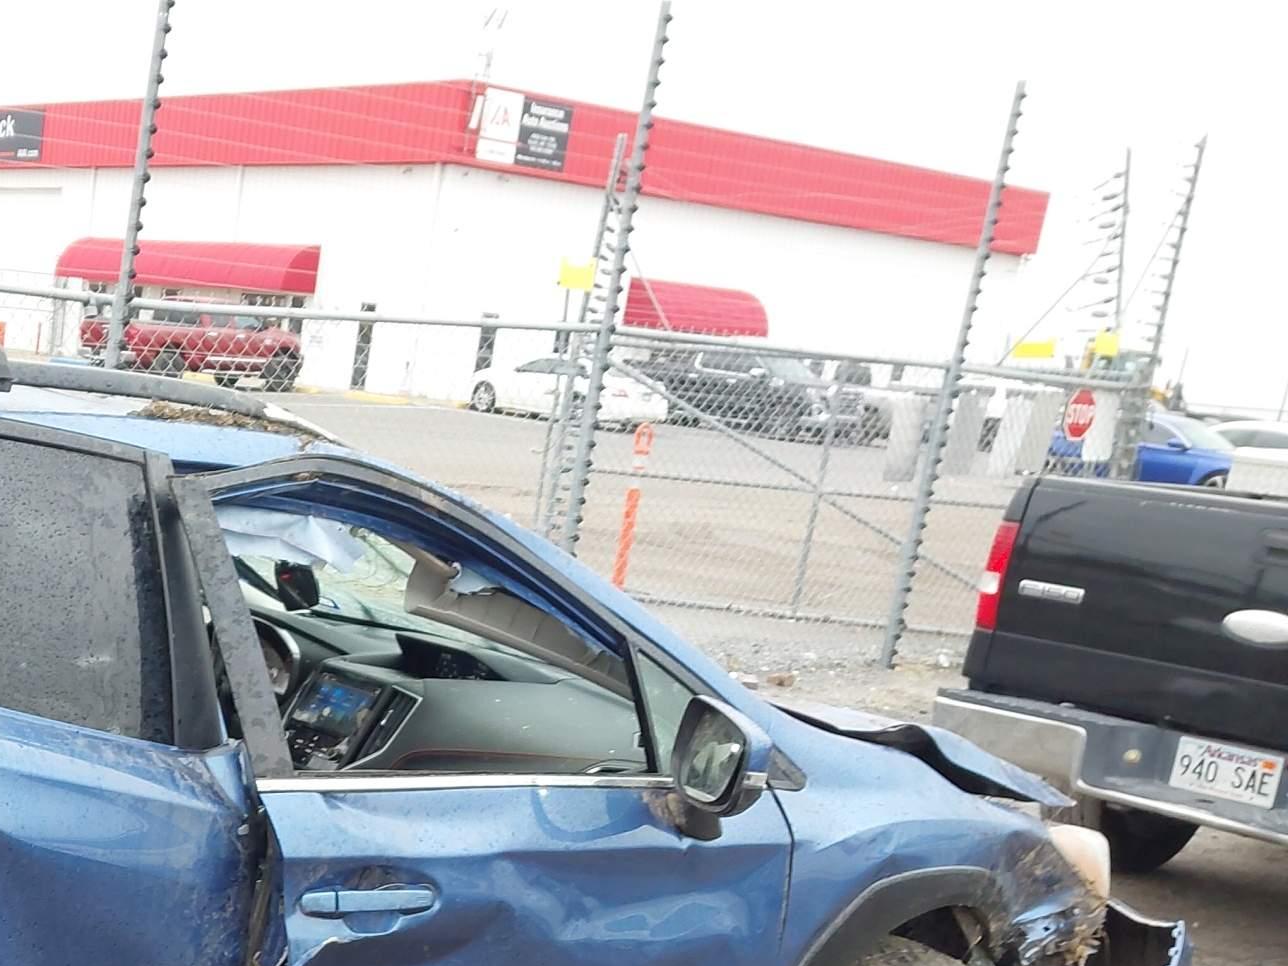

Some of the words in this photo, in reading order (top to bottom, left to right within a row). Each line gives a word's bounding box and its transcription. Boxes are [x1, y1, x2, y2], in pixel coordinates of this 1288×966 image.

[1065, 404, 1096, 425] STOP
[1180, 754, 1218, 783] 940
[1232, 766, 1274, 797] SAE
